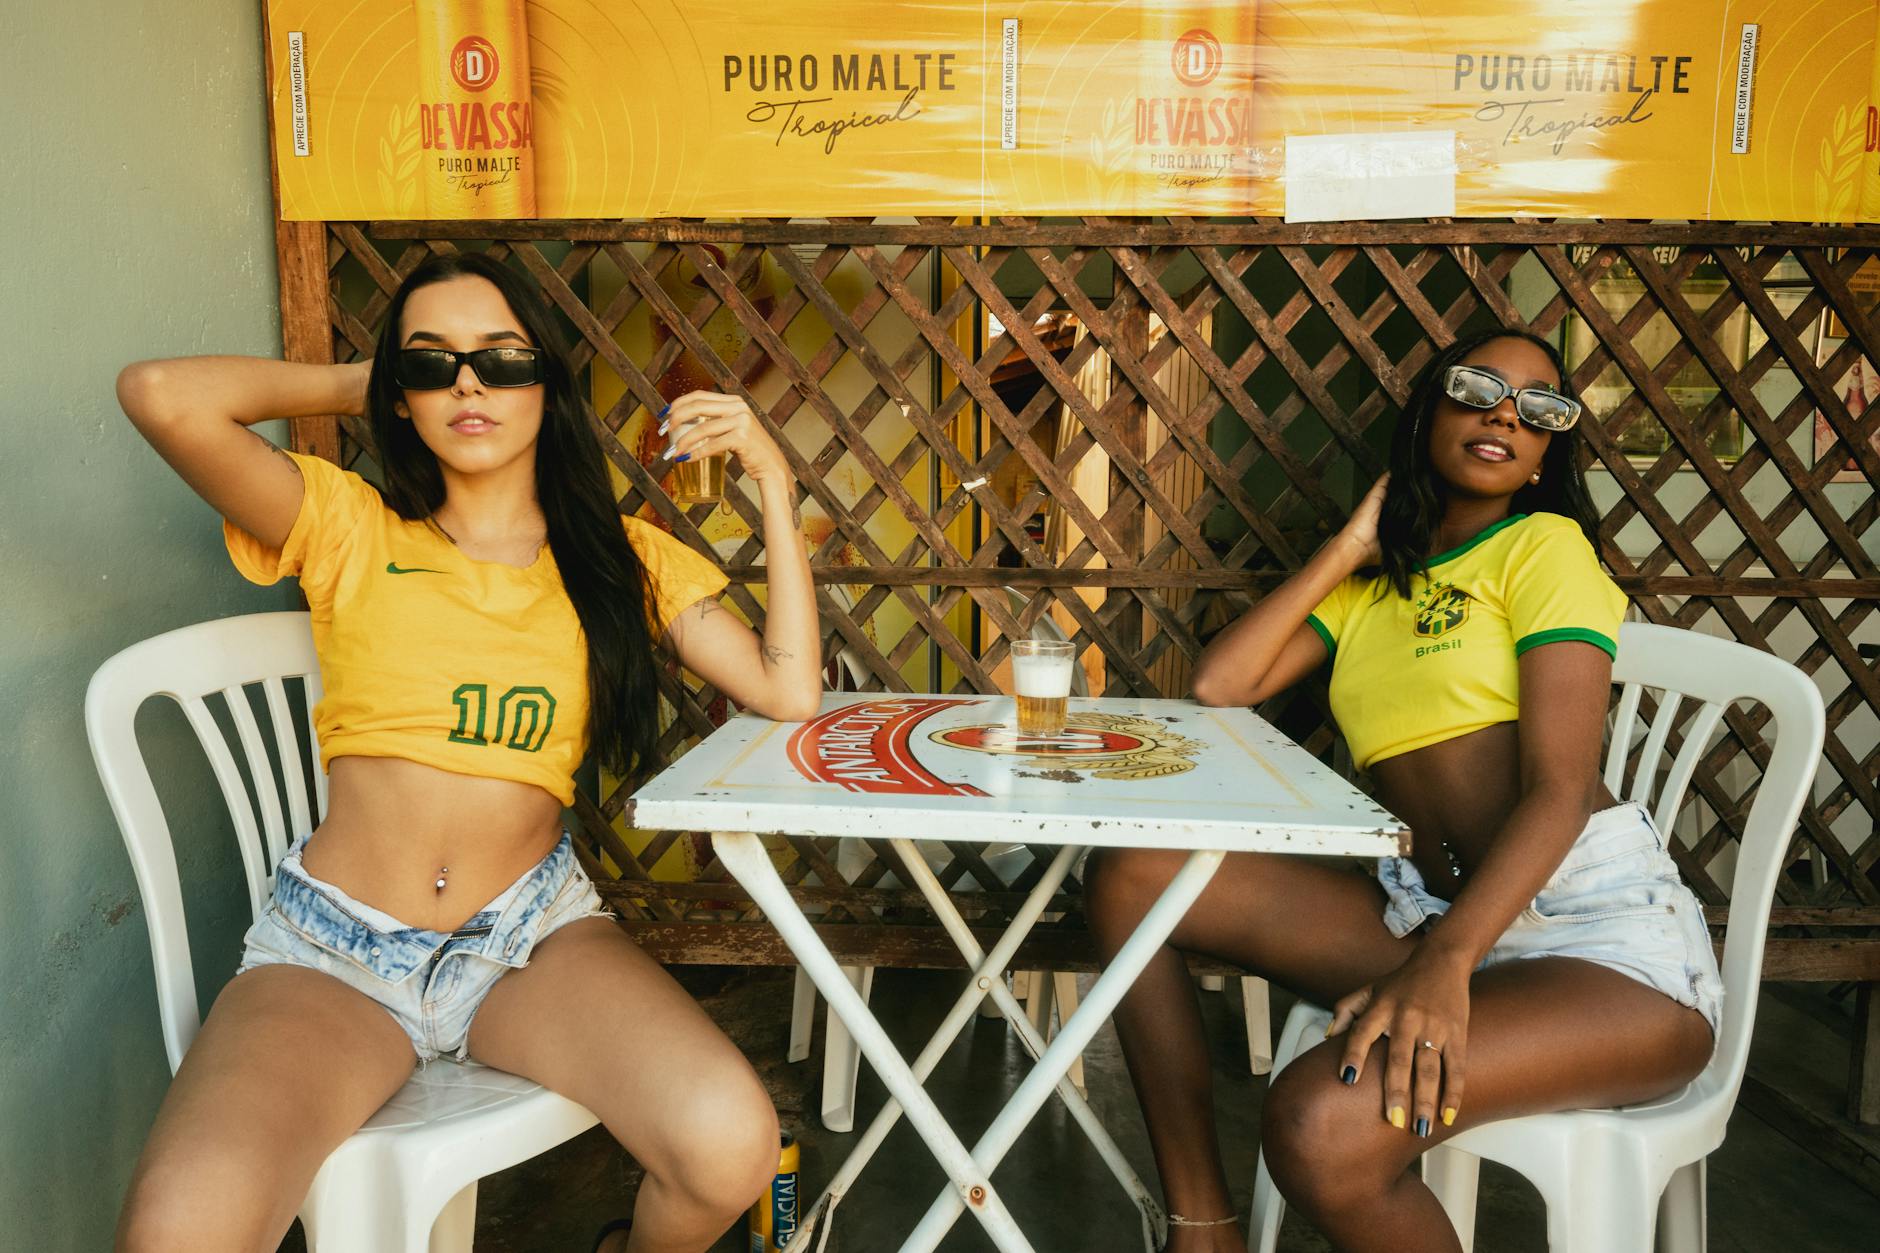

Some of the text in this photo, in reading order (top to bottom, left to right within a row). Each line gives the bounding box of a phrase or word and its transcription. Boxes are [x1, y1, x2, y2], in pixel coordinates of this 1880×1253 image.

[466, 50, 484, 82] D
[724, 53, 956, 92] PURO MALTE
[1187, 45, 1206, 76] D
[1454, 54, 1692, 94] PURO MALTE
[1740, 29, 1754, 88] MODERAÇÃO.
[292, 37, 306, 151] APRECIE COM MODERAÇÃO.
[1004, 85, 1013, 106] COM
[1738, 90, 1747, 110] COM
[420, 101, 533, 151] DEVASSA
[746, 86, 921, 155] Tropical
[1004, 108, 1013, 144] APRECIE
[1135, 97, 1251, 146] DEVASSA
[1474, 88, 1653, 156] Tropical
[1735, 112, 1746, 148] APRECIE
[438, 156, 521, 173] PURO MALTE
[1150, 153, 1236, 169] PURO MALTE
[446, 169, 511, 197] Tropical
[1157, 167, 1224, 193] Tropical
[1652, 246, 1681, 264] SEU
[1415, 639, 1462, 658] Brasil
[448, 683, 557, 752] 10
[816, 702, 928, 784] ANTARCTICA
[777, 1174, 796, 1248] GLACIAL
